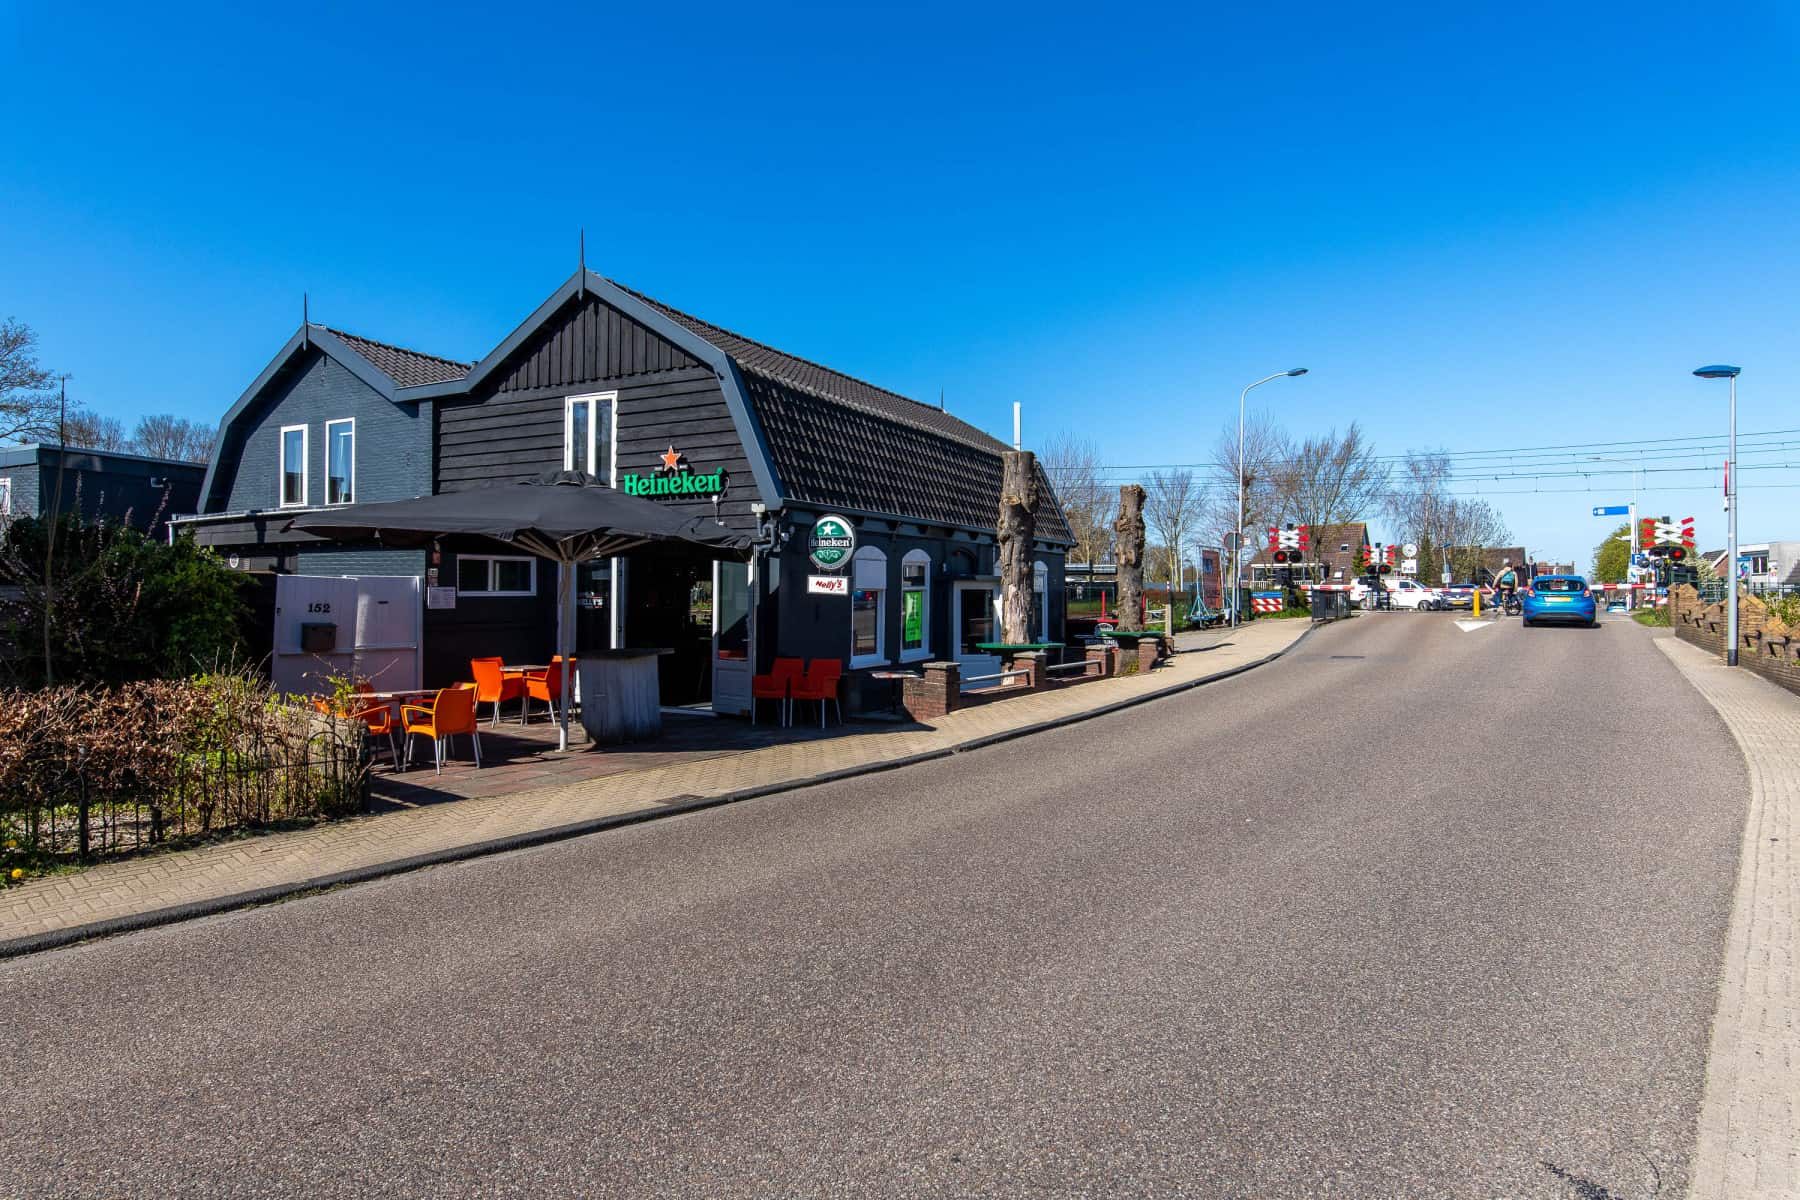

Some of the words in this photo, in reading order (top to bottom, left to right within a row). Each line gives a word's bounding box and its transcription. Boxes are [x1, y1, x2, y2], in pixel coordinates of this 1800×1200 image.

[624, 470, 722, 496] Heineken
[810, 537, 850, 548] Heineken
[308, 603, 331, 614] 152
